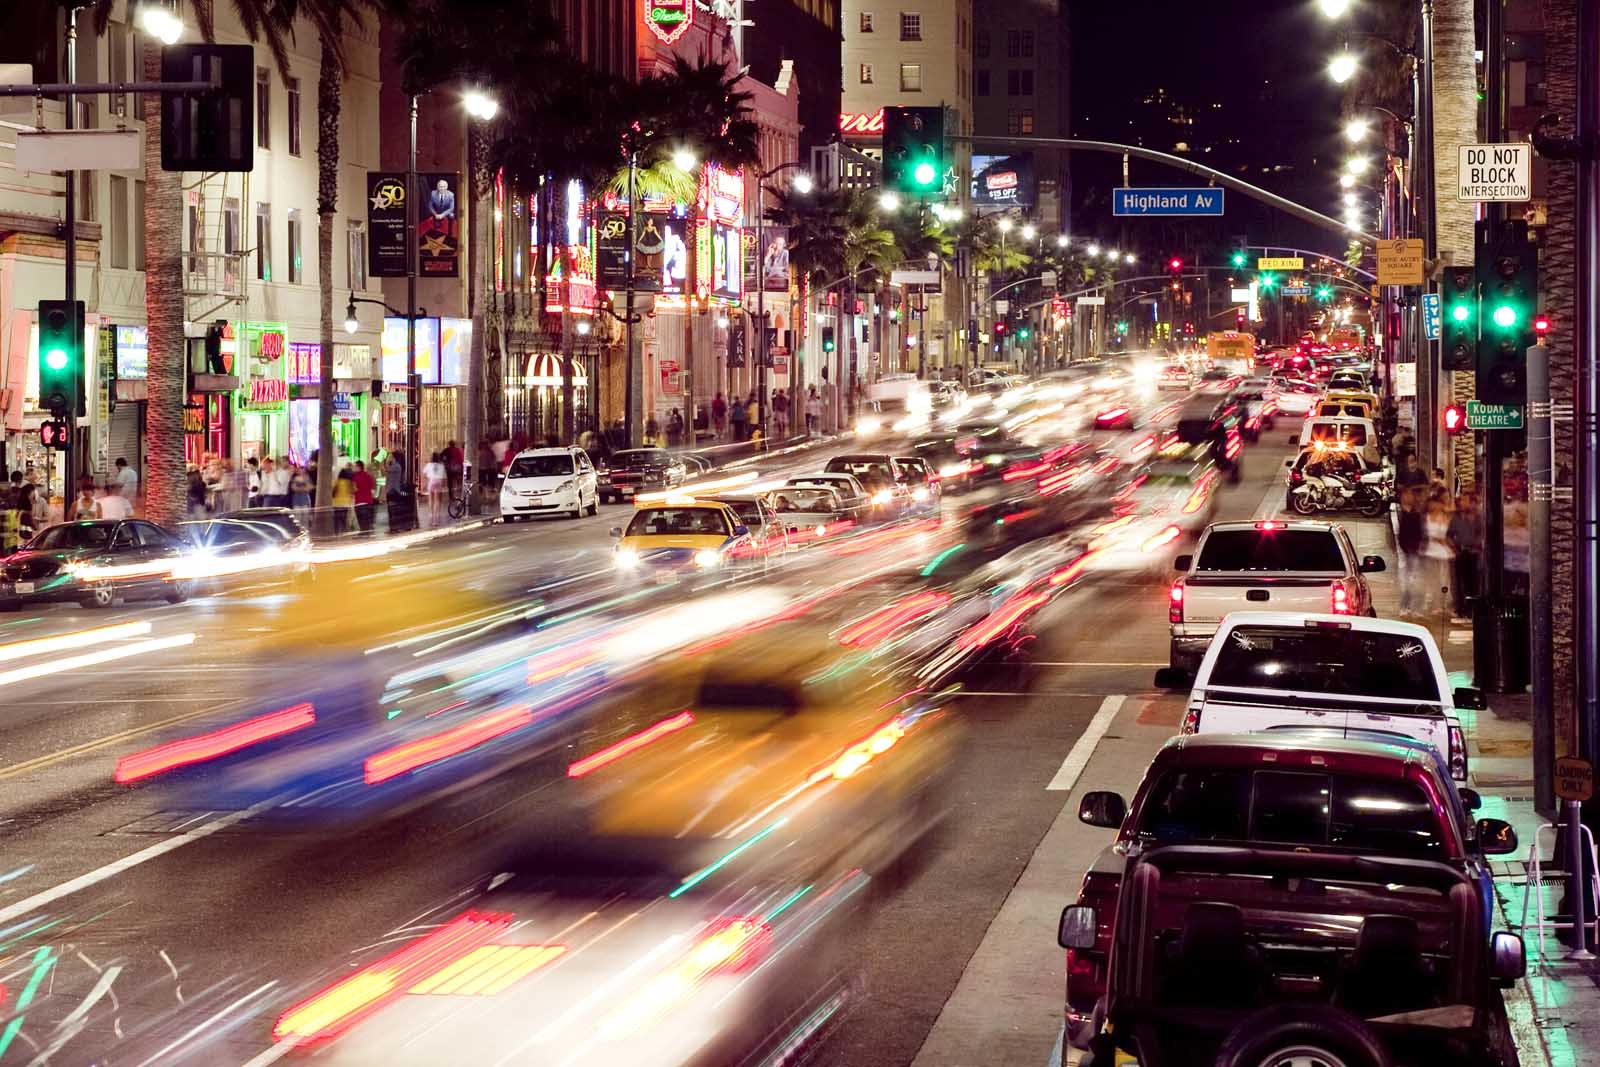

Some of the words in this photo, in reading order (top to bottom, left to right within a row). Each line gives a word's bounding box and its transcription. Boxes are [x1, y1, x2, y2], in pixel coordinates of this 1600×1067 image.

[1468, 149, 1486, 165] DO
[1494, 149, 1520, 165] NOT
[1471, 167, 1516, 183] BLOCK
[381, 185, 405, 209] 50
[1461, 185, 1526, 197] INTERSECTION
[1123, 194, 1188, 212] Highland
[1195, 194, 1213, 208] Av
[607, 221, 626, 238] 50
[1262, 260, 1279, 268] PED
[1281, 260, 1300, 268] XING
[736, 330, 744, 362] ZARA
[249, 378, 288, 403] PIZZERIA
[1473, 403, 1505, 414] KODAK
[1470, 415, 1510, 425] THEATRE
[1554, 766, 1593, 777] LOADING
